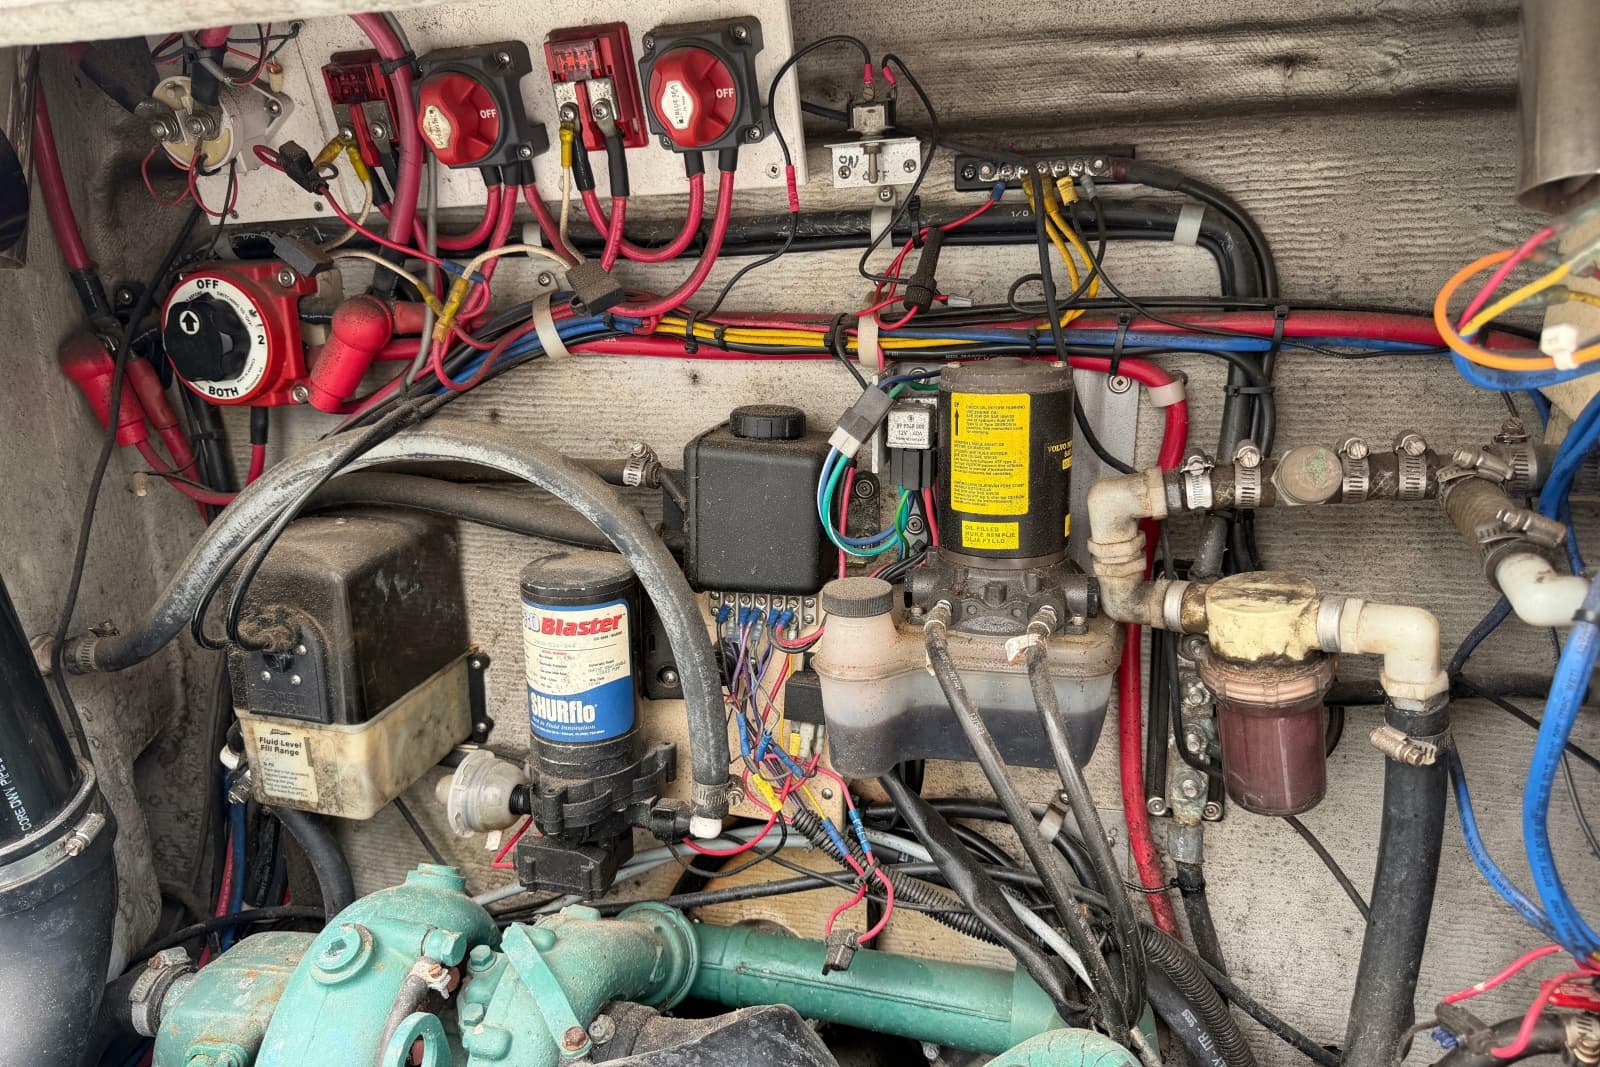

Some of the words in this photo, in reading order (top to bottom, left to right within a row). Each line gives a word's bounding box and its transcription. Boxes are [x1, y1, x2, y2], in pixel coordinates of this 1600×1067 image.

[715, 88, 735, 98] OFF
[480, 109, 497, 118] OFF
[839, 155, 860, 168] ON
[196, 279, 219, 289] OFF
[257, 335, 265, 345] 2
[208, 386, 239, 397] BOTH
[1047, 443, 1067, 454] VOLVO
[541, 613, 623, 637] Blaster
[530, 692, 596, 723] SHURflo
[260, 736, 279, 746] Fluid
[281, 740, 302, 749] Level
[275, 747, 300, 757] Range
[14, 806, 32, 831] CORE
[1198, 1032, 1214, 1051] ITR
